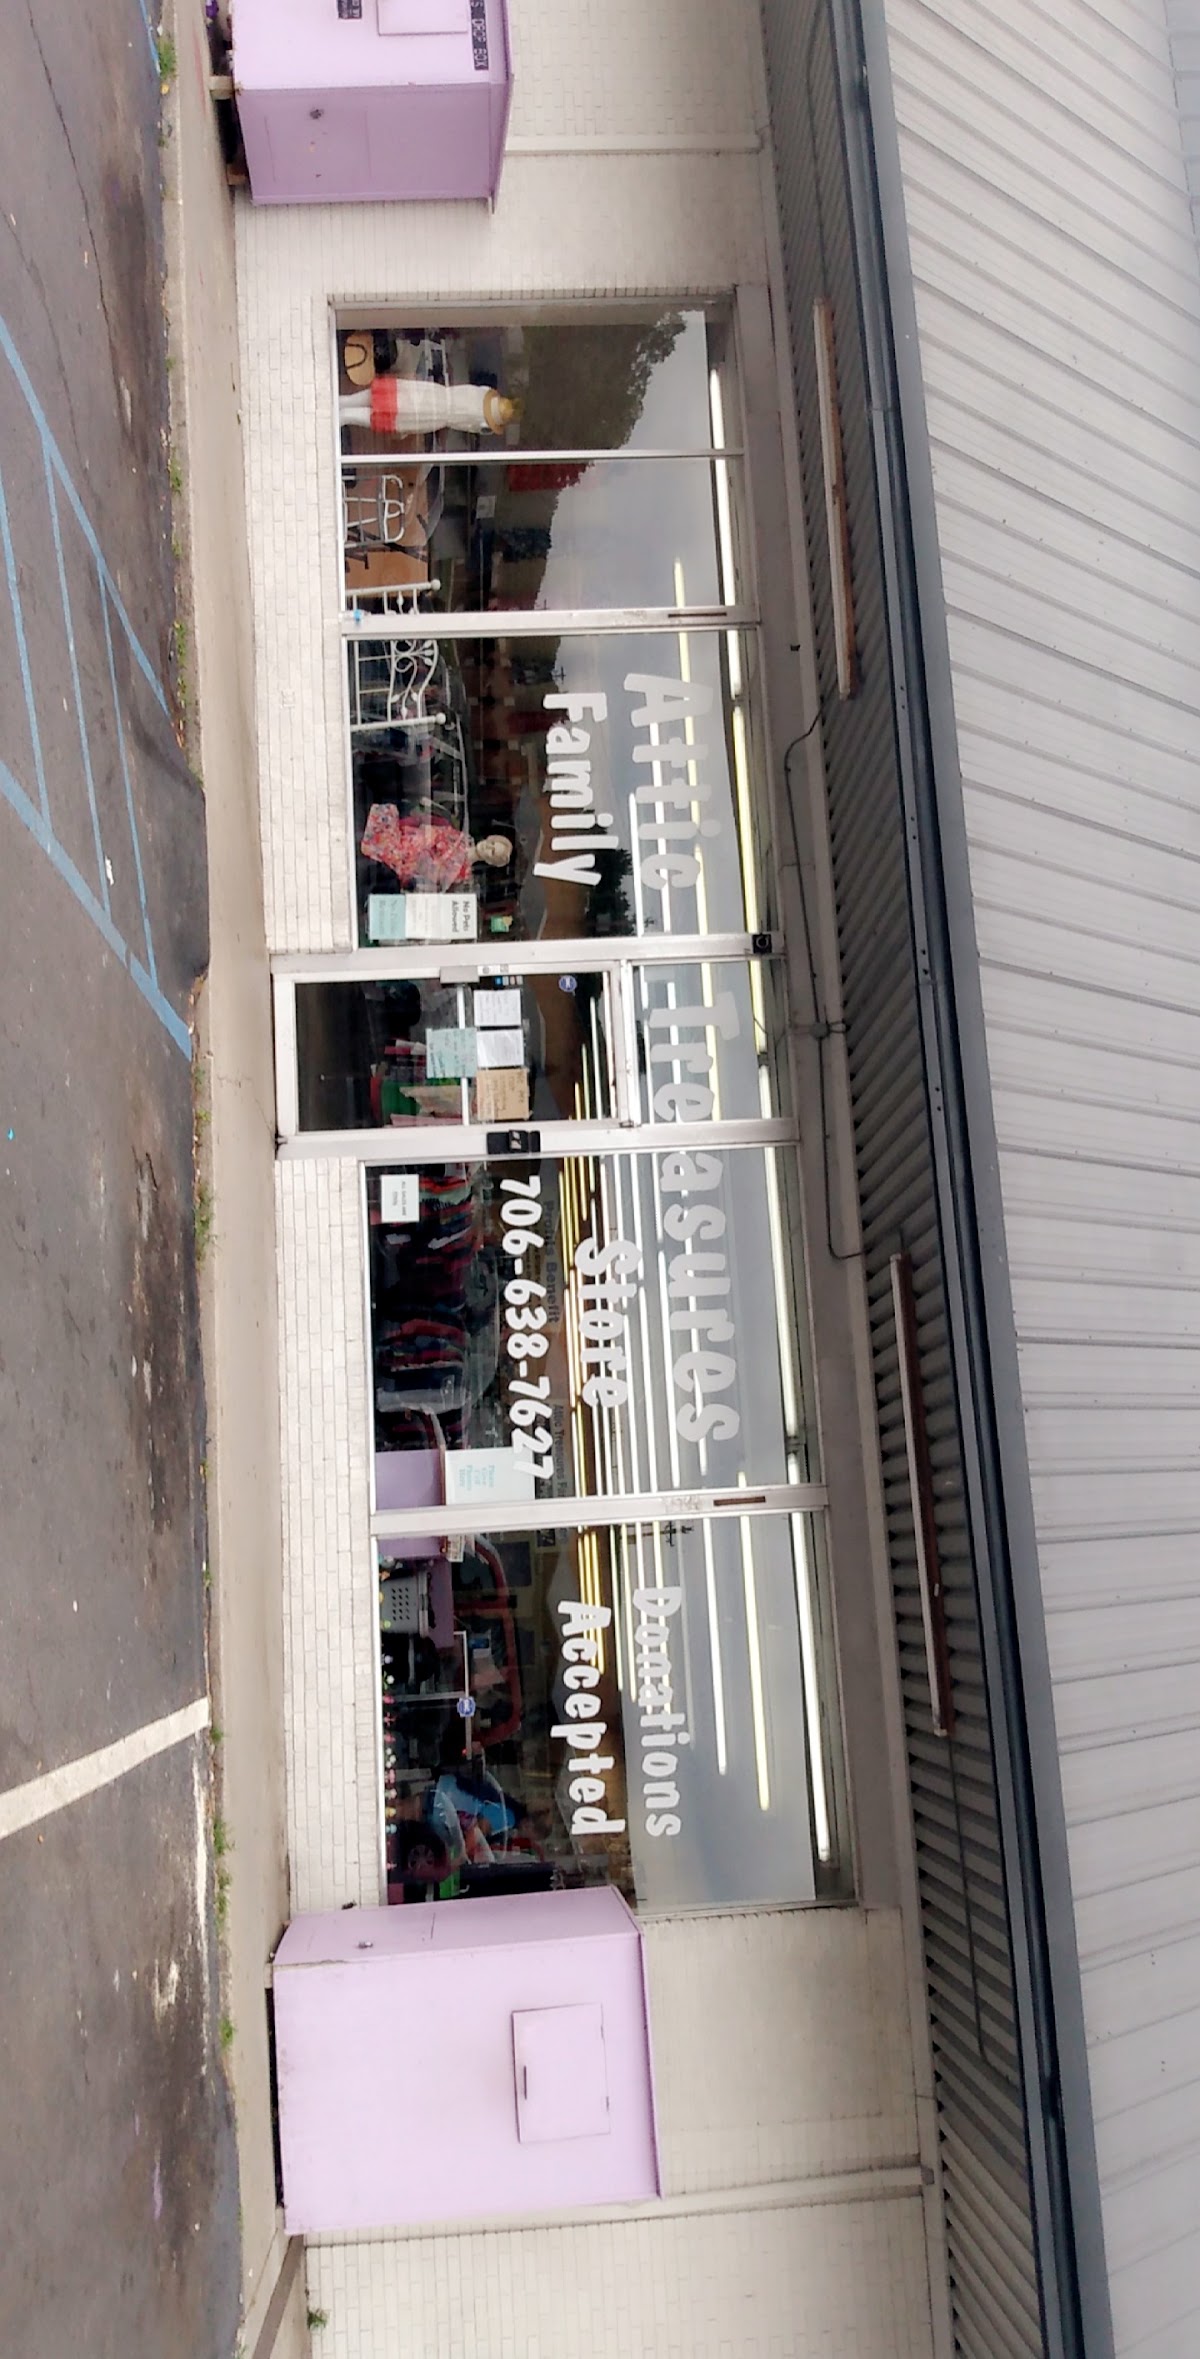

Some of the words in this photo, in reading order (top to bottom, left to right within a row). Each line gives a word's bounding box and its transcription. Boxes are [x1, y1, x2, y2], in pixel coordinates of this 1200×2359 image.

[472, 18, 486, 43] DROP
[473, 48, 488, 68] BOX
[532, 691, 619, 887] Family
[623, 672, 722, 891] Attic
[451, 900, 460, 933] Allowed
[462, 900, 471, 913] No
[462, 914, 471, 932] Pets
[648, 991, 741, 1444] Treasures
[545, 1262, 560, 1324] Benefit
[573, 1237, 643, 1409] Store
[499, 1174, 555, 1480] 706-638-7627
[553, 1404, 566, 1428] Attic
[554, 1429, 567, 1480] Treasures
[550, 1600, 626, 1836] Accepted
[631, 1586, 691, 1838] Donations
